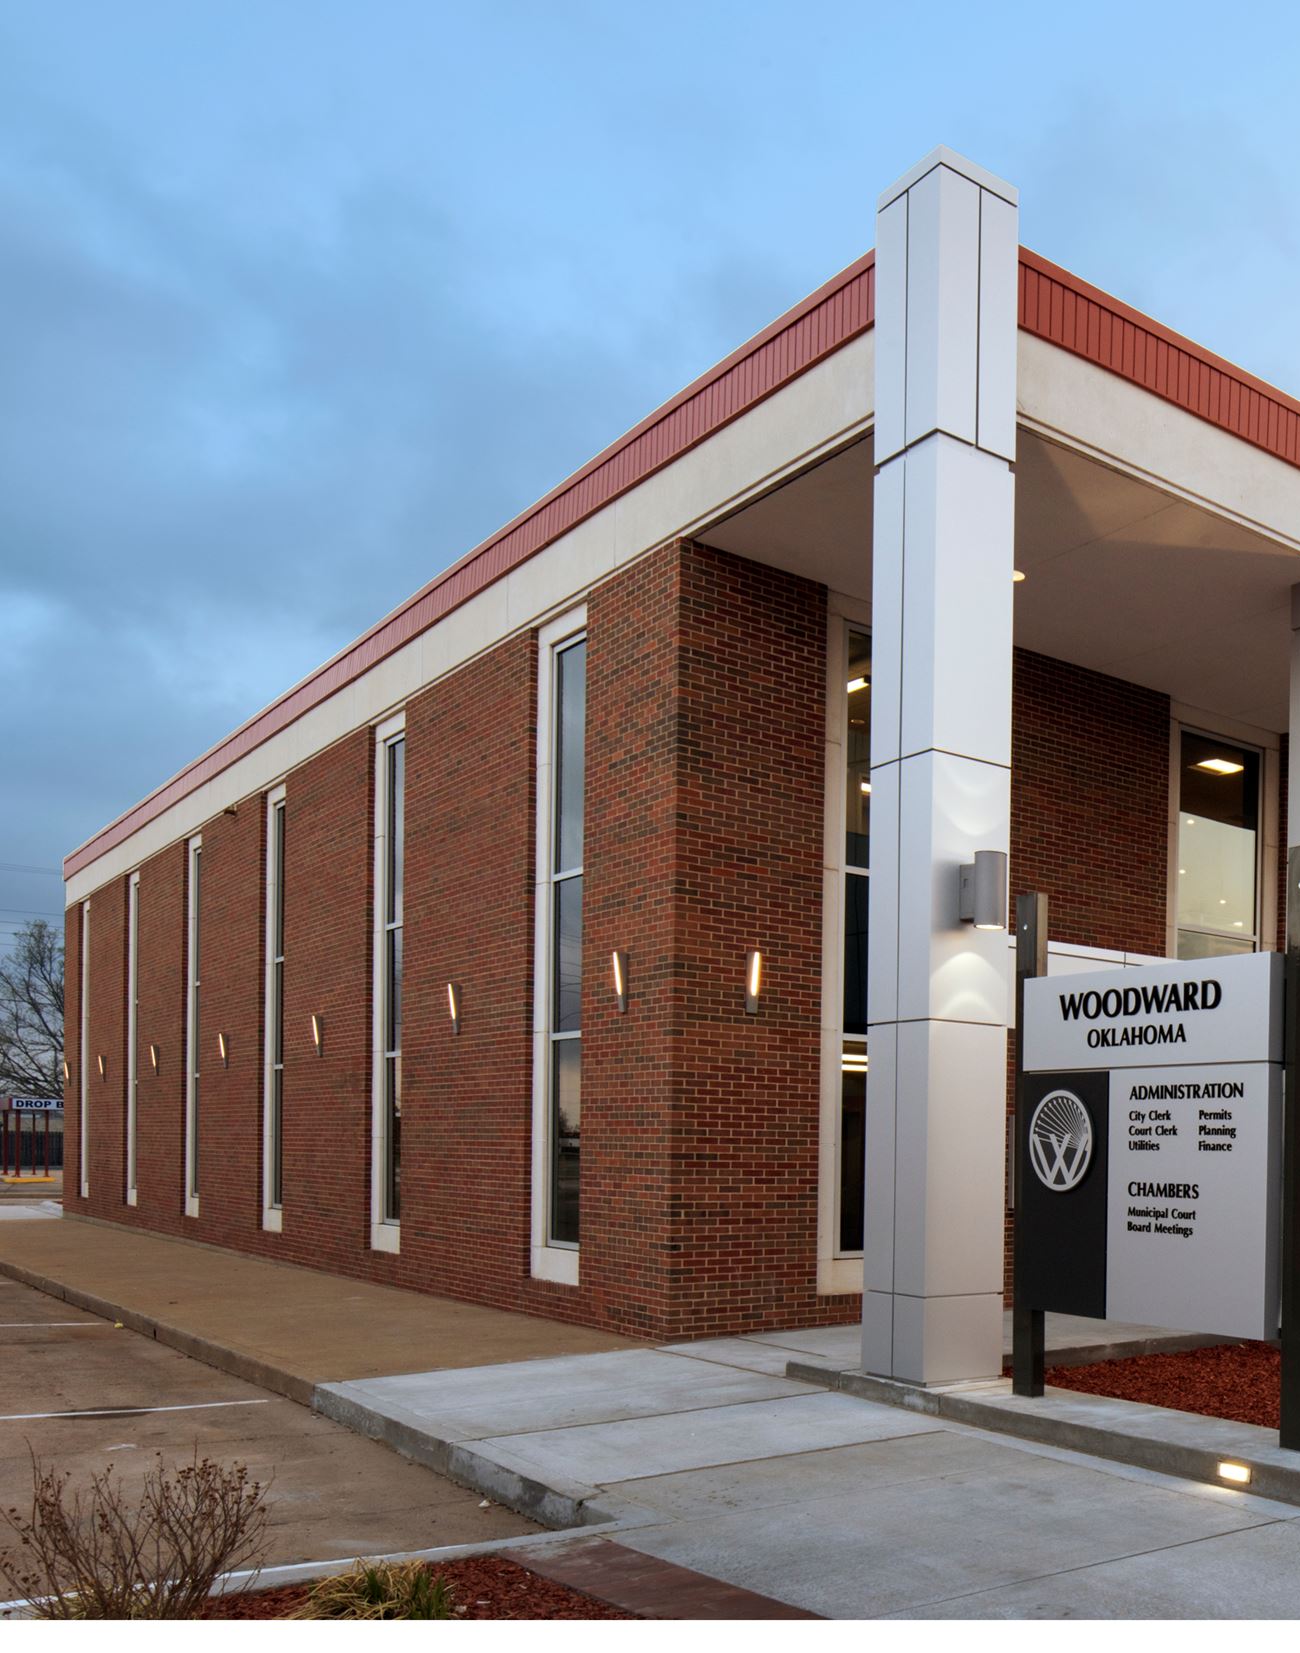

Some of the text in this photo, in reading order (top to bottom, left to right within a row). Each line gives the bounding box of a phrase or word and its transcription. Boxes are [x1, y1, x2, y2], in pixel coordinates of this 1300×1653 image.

[1059, 979, 1222, 1021] WOODWARD
[1087, 1023, 1187, 1049] OKLAHOMA
[1129, 1082, 1244, 1101] ADMINISTRATION
[16, 1100, 51, 1108] DROP
[1129, 1110, 1171, 1123] City Clerk
[1198, 1109, 1233, 1121] Permits
[1128, 1125, 1178, 1136] Court Clerk
[1198, 1124, 1237, 1139] Planning
[1128, 1140, 1160, 1151] Utilities
[1198, 1140, 1233, 1152] Finance
[1128, 1181, 1200, 1200] CHAMBERS
[1127, 1206, 1196, 1221] Municipal Court
[1127, 1221, 1194, 1239] Board Meetings
